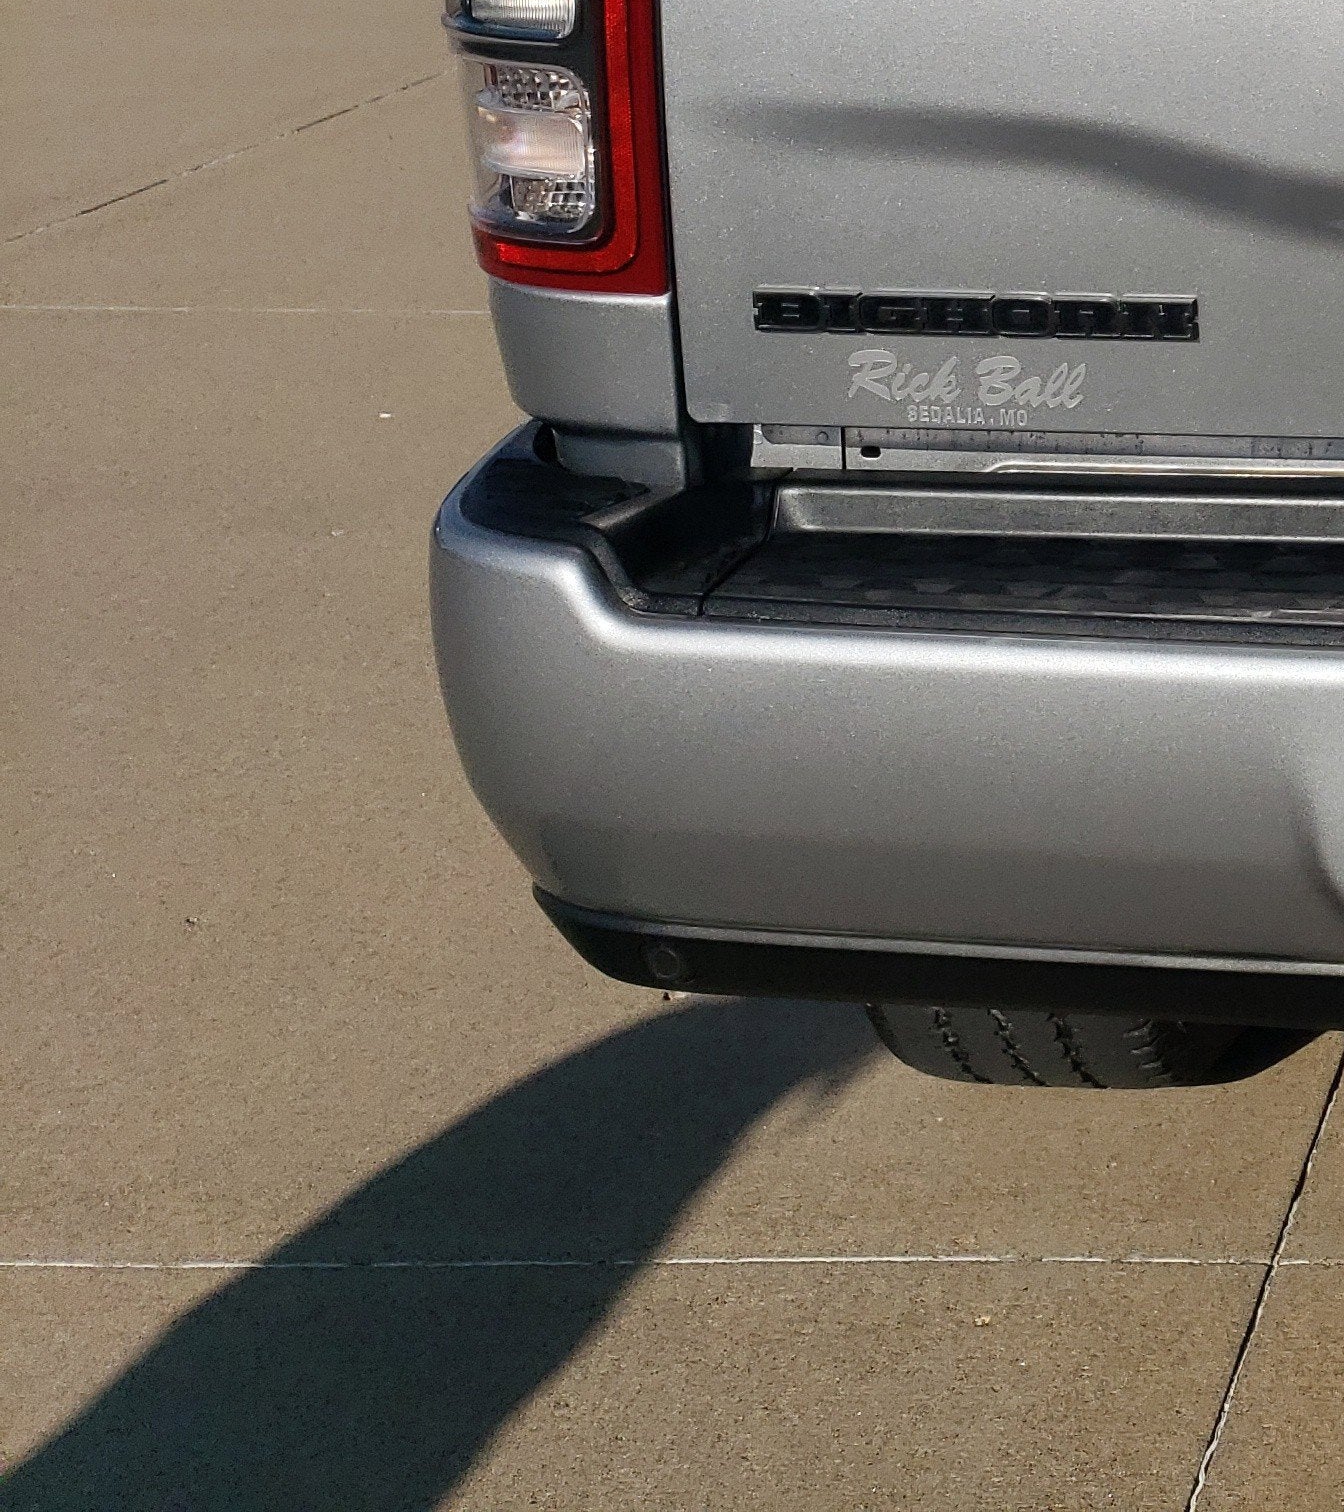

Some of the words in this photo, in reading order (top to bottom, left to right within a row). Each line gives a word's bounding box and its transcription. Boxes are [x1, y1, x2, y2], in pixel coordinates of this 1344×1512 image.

[848, 349, 964, 403] Rick
[975, 355, 1087, 409] Ball
[1000, 408, 1029, 426] MO
